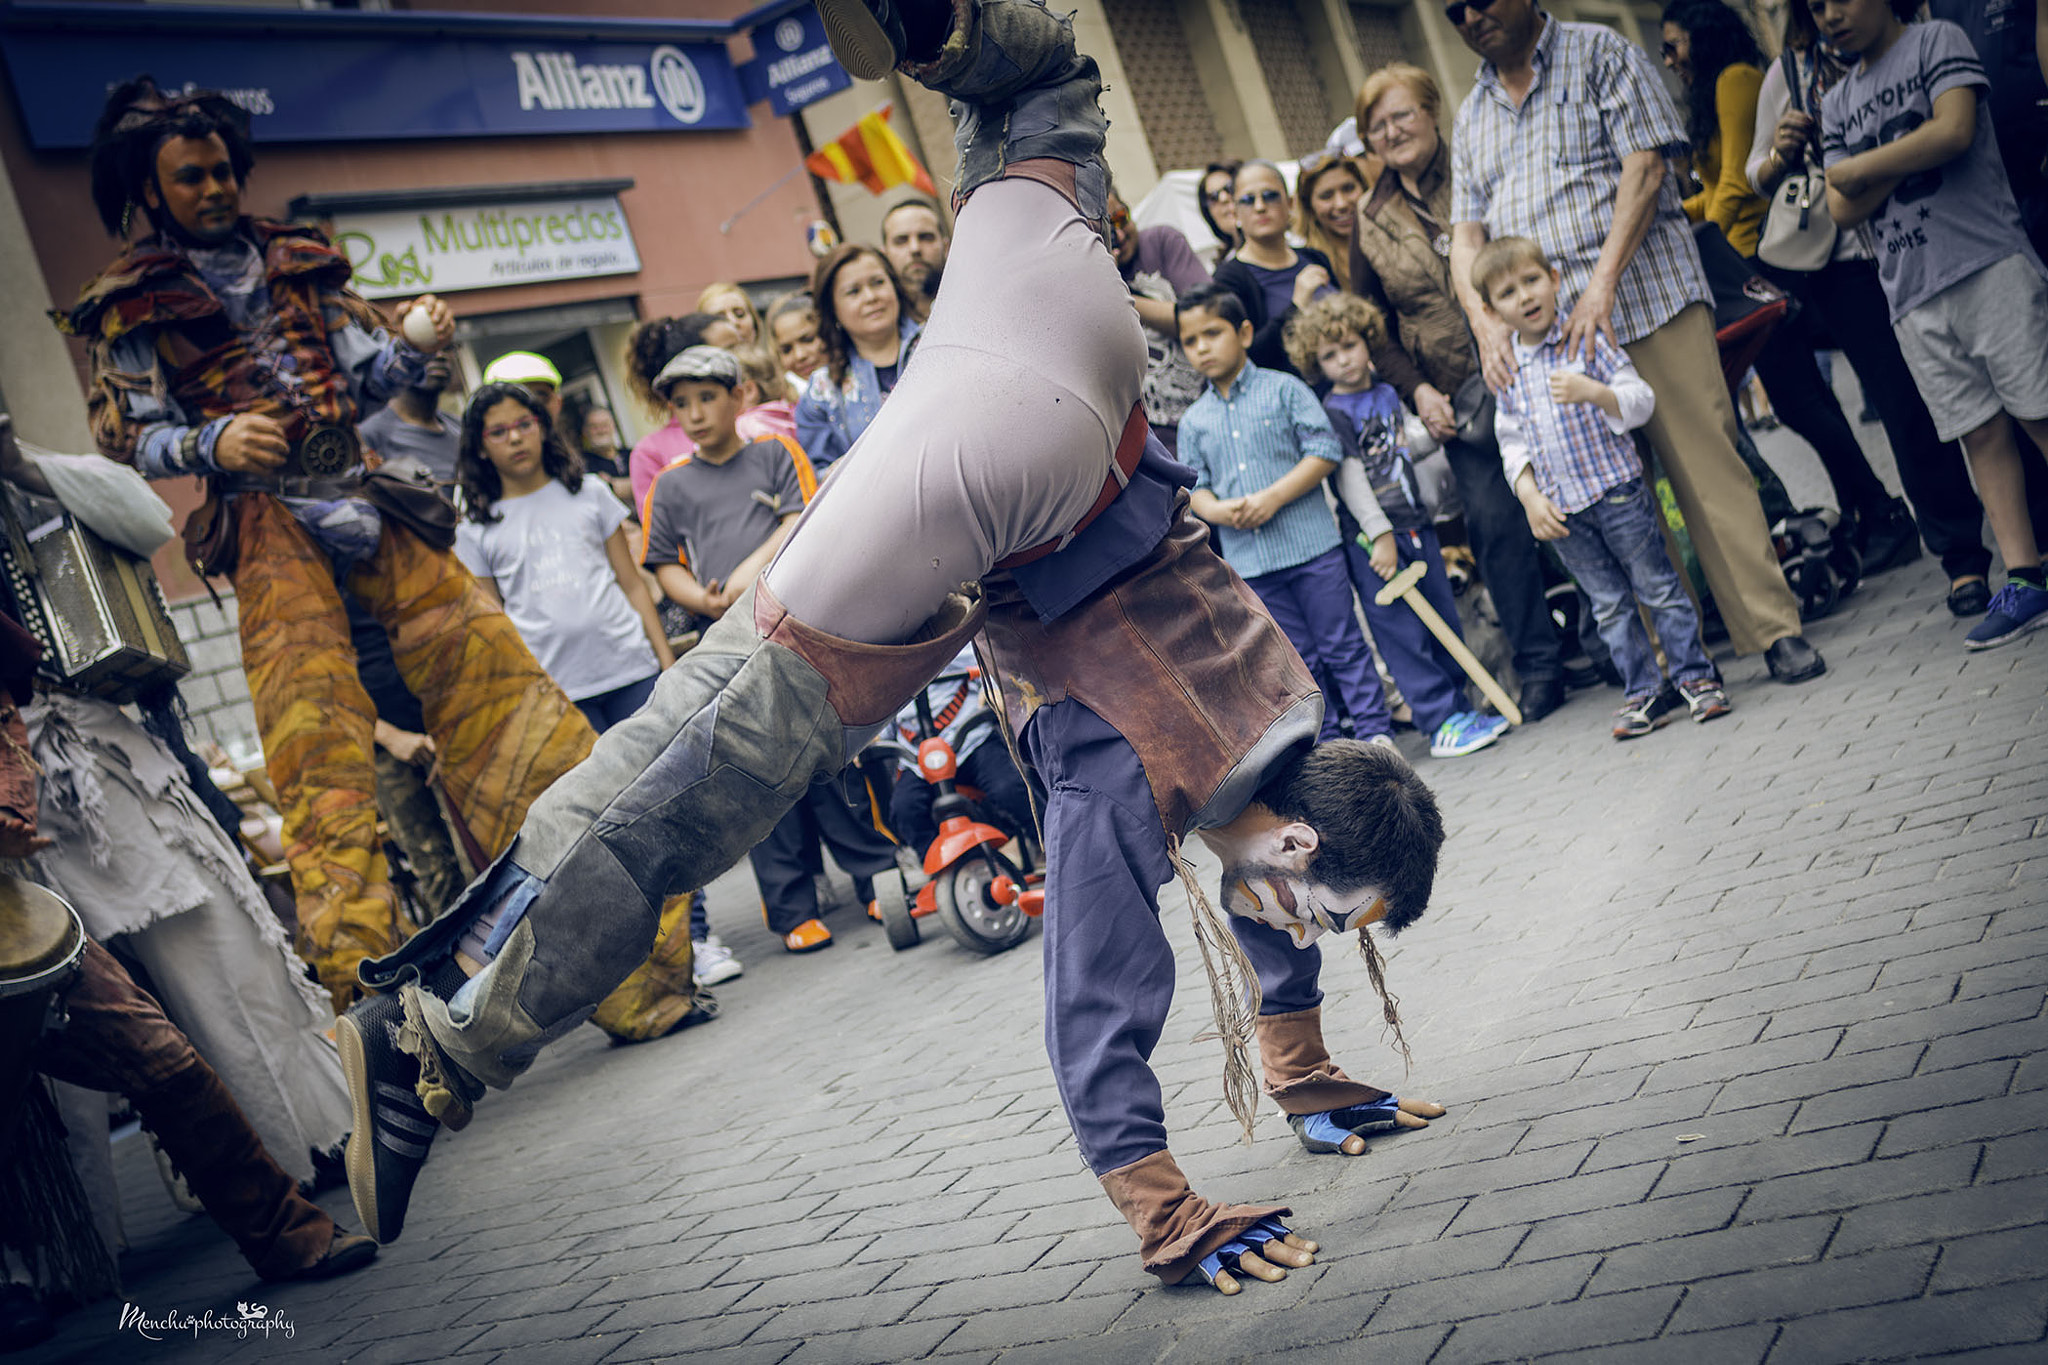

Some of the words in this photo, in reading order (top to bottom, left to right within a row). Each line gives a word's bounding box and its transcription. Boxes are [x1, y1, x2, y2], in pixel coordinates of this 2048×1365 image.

[511, 52, 656, 110] Allianz
[767, 44, 834, 89] Allianz
[418, 205, 624, 258] Multiprecios
